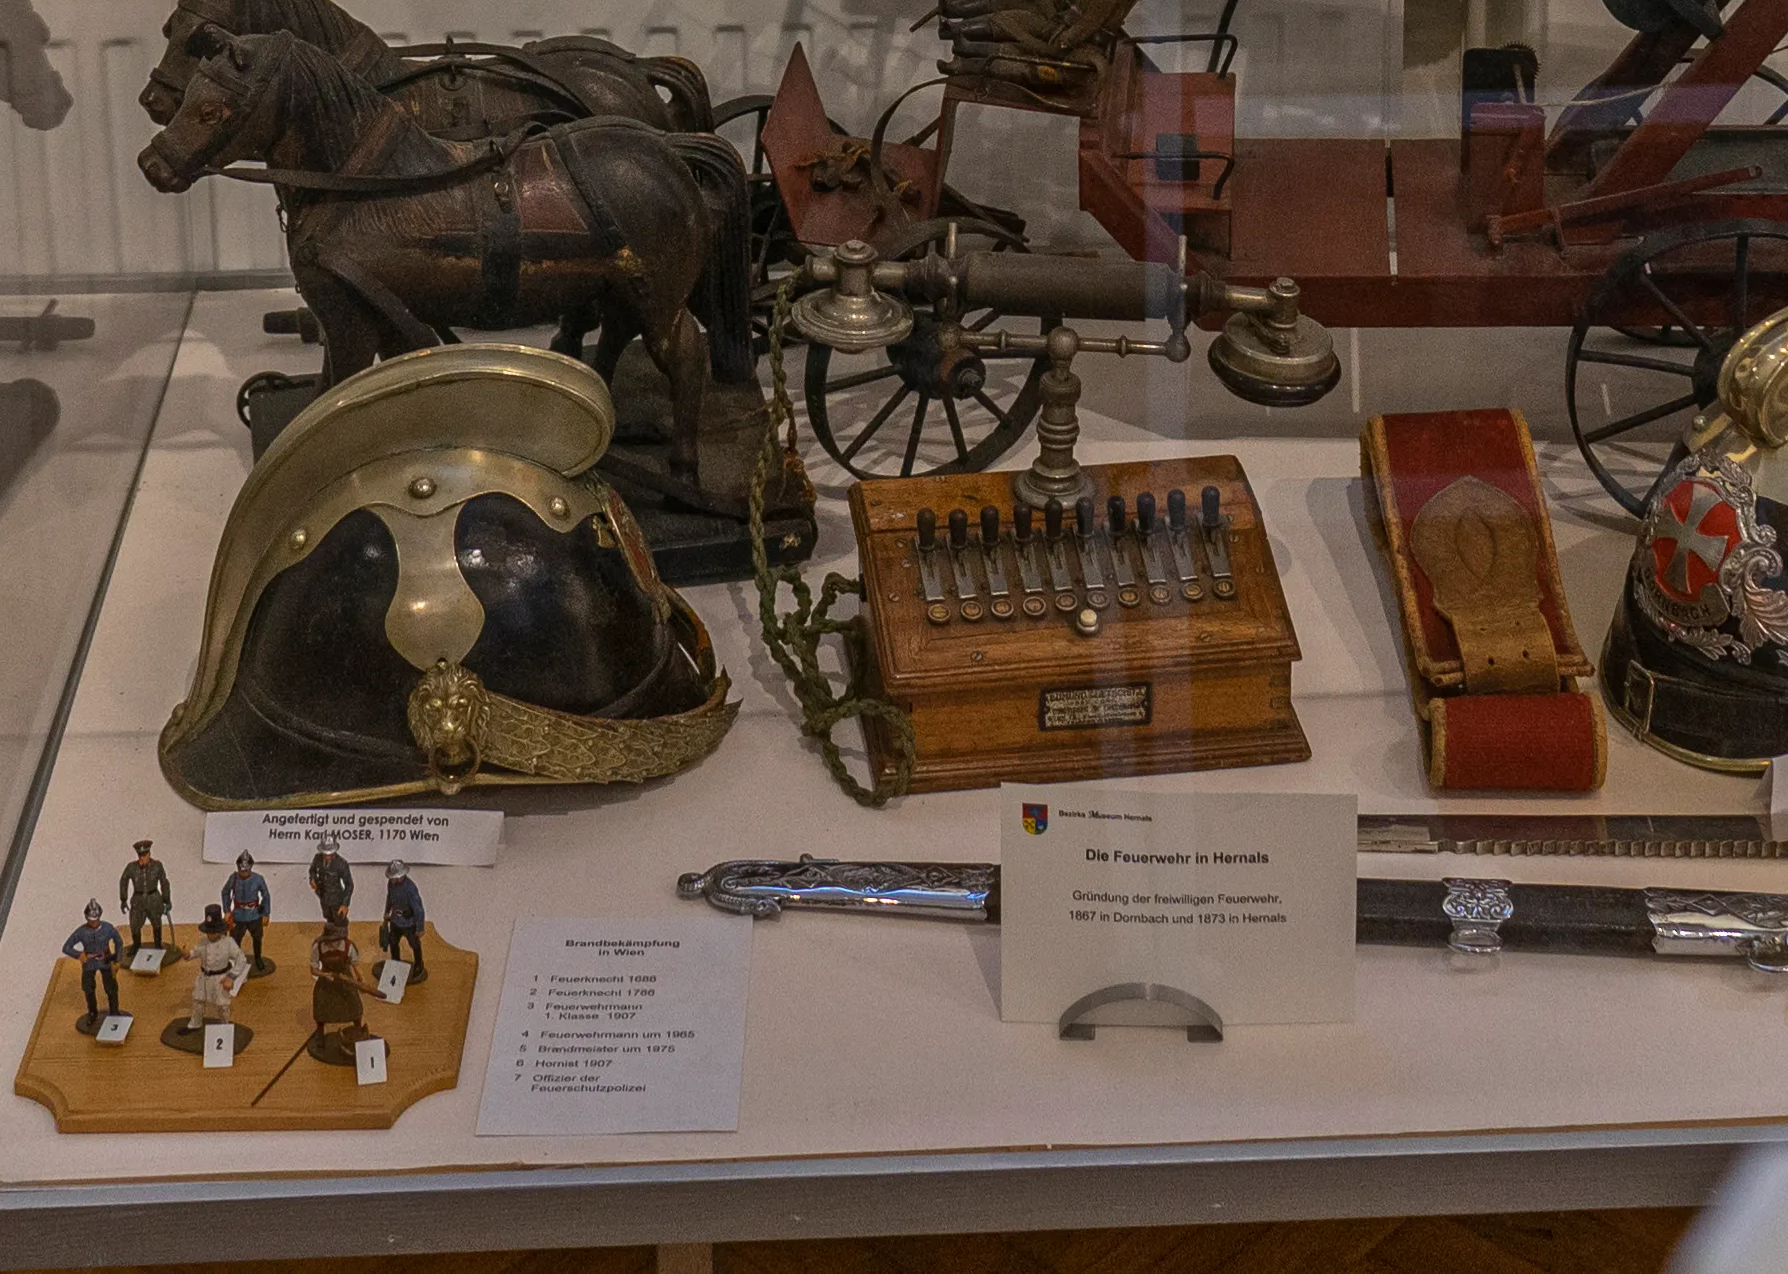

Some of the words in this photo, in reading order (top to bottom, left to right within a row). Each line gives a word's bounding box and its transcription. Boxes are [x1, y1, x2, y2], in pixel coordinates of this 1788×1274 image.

[262, 813, 329, 827] Angefertigt
[332, 813, 355, 825] und
[358, 813, 423, 828] gespendet
[426, 817, 449, 827] von
[268, 828, 301, 840] Herrn
[378, 829, 407, 841] 1170
[410, 830, 440, 842] Wien
[1085, 848, 1110, 863] Die
[1113, 850, 1191, 865] Feuerwehr
[1195, 851, 1209, 865] in
[1213, 851, 1270, 865] Hernals
[1072, 889, 1129, 905] Gründung
[1132, 892, 1152, 904] der
[1154, 893, 1215, 907] freiwilligen
[1068, 910, 1096, 922] 1867
[1099, 911, 1111, 922] in
[1113, 911, 1169, 924] Dornbach
[1172, 913, 1194, 924] und
[1198, 913, 1226, 925] 1873
[1229, 913, 1240, 924] in
[1242, 912, 1287, 924] Hernals
[565, 939, 681, 949] Brandbekämpfung
[598, 948, 610, 957] in
[613, 948, 645, 957] Wien
[550, 974, 624, 983] Feuerknecht
[548, 988, 622, 997] Feuerknecht
[545, 1002, 643, 1011] Feuerwehrmann
[558, 1012, 600, 1020] Klasse
[607, 1012, 637, 1020] 1907
[540, 1030, 639, 1039] Feuerwehrmann
[642, 1031, 661, 1039] um
[215, 1038, 224, 1050] 2
[537, 1044, 620, 1053] Brandmeister
[622, 1045, 642, 1053] um
[534, 1059, 579, 1068] Hornist
[582, 1059, 613, 1068] 1907
[532, 1073, 577, 1082] Offizier
[579, 1074, 601, 1082] der
[530, 1083, 647, 1093] Feuerschutzpolizei
